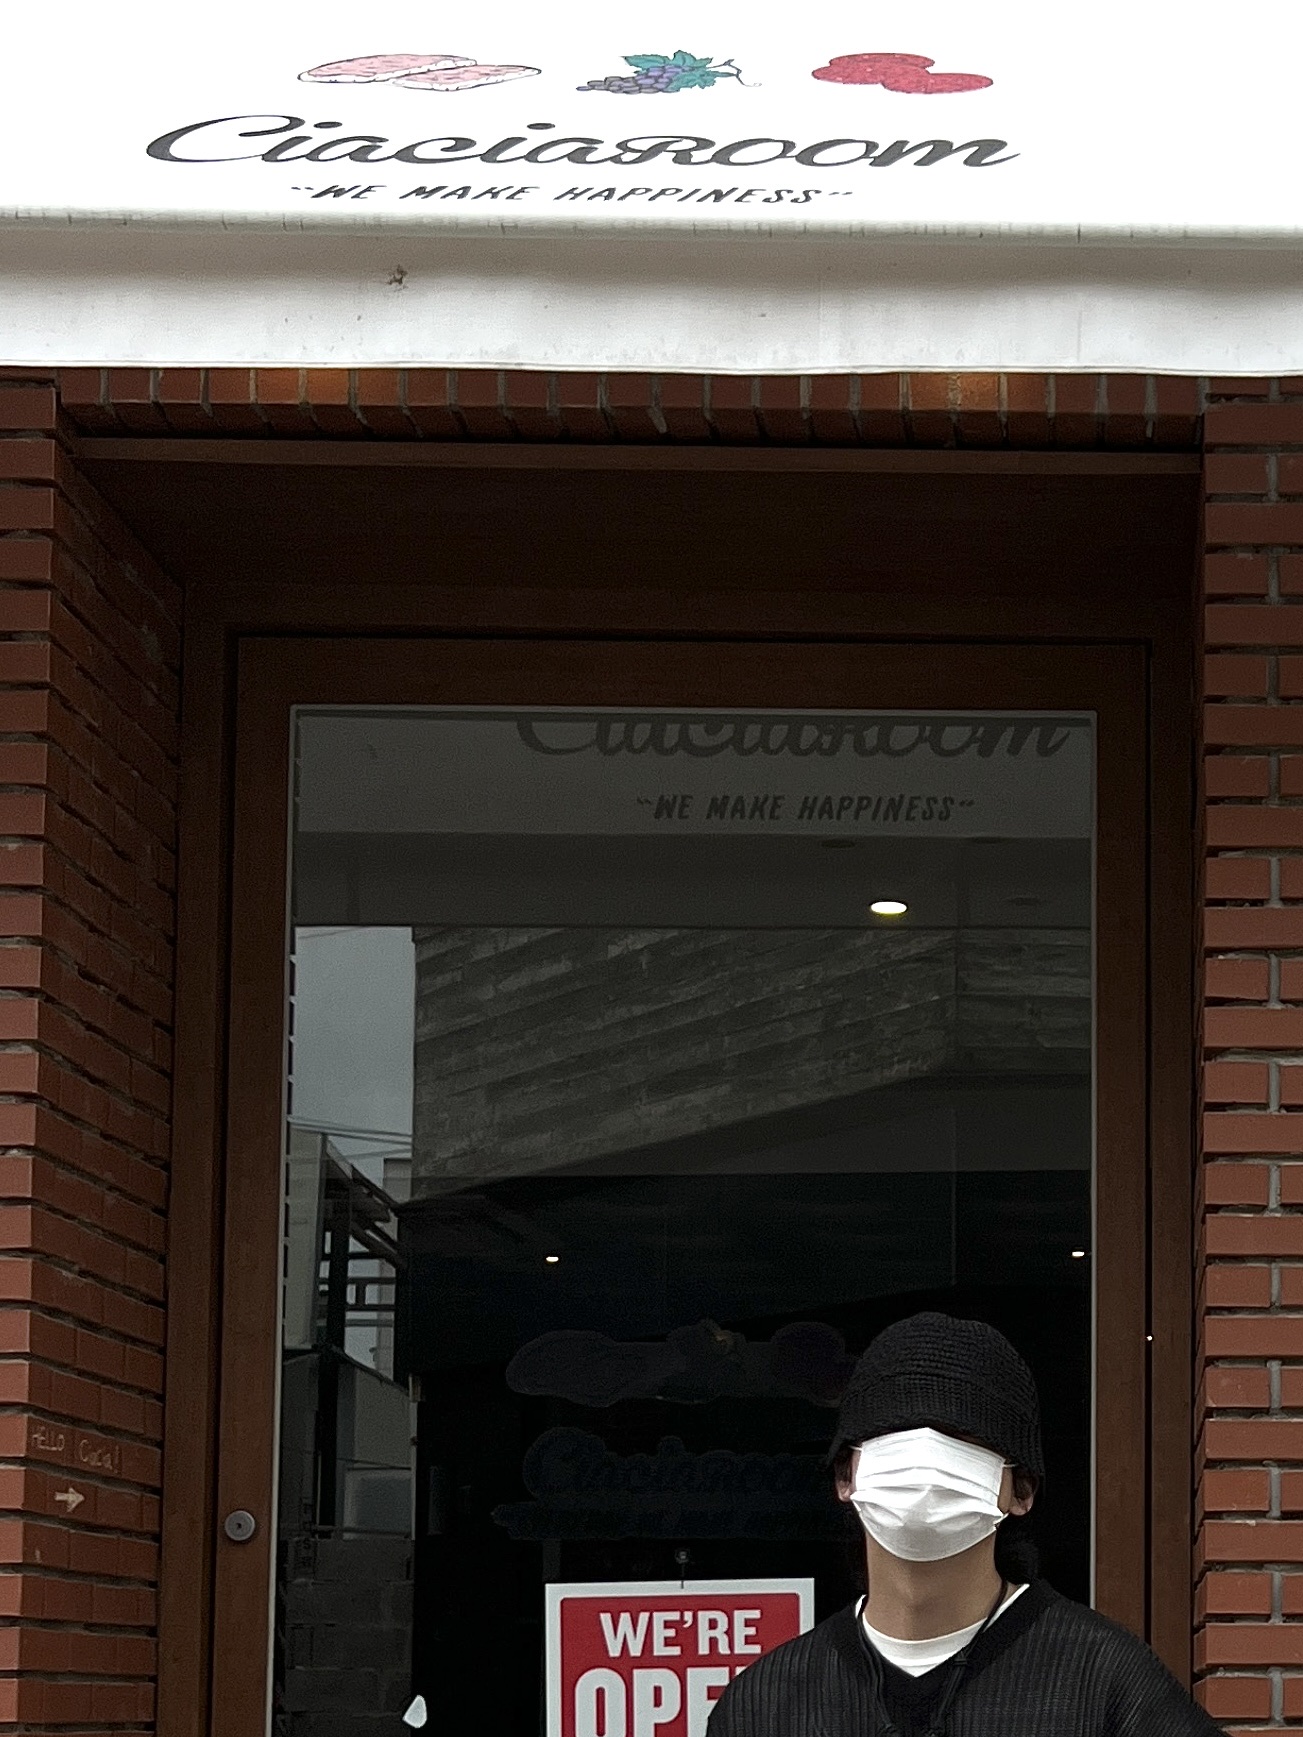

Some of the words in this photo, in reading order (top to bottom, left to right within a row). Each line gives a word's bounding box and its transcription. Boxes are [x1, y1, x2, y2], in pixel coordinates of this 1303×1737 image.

[399, 185, 541, 203] MAKE
[705, 795, 784, 822] MAKE
[600, 1609, 762, 1658] WE'RE
